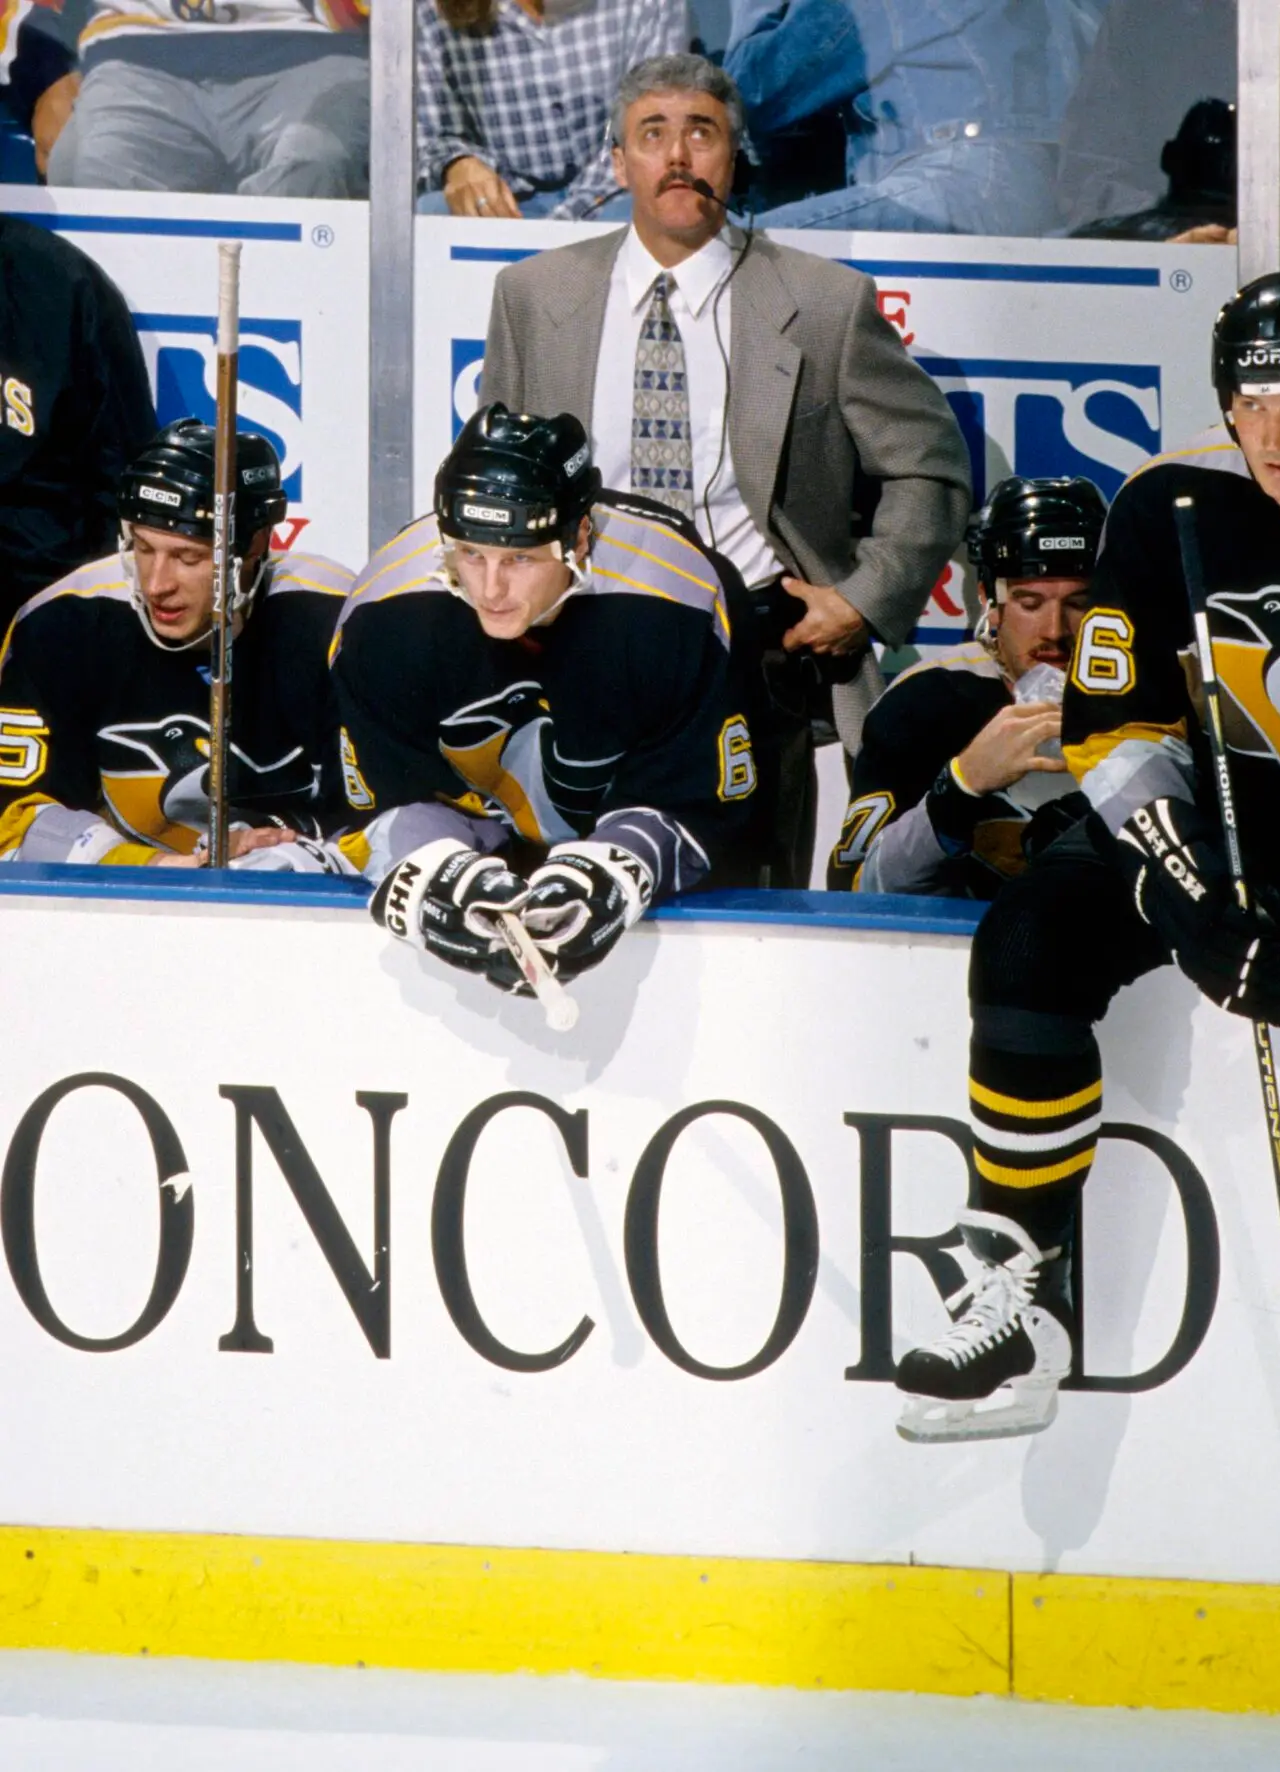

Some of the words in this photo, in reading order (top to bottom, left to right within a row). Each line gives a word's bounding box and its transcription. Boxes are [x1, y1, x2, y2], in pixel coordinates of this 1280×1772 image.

[140, 486, 180, 507] CCM
[463, 504, 510, 522] CCM
[1039, 537, 1085, 550] CCM
[717, 714, 757, 802] 6
[1218, 754, 1236, 825] KOHO
[1131, 807, 1208, 902] KOHO
[0, 1071, 1221, 1394] ONCORD
